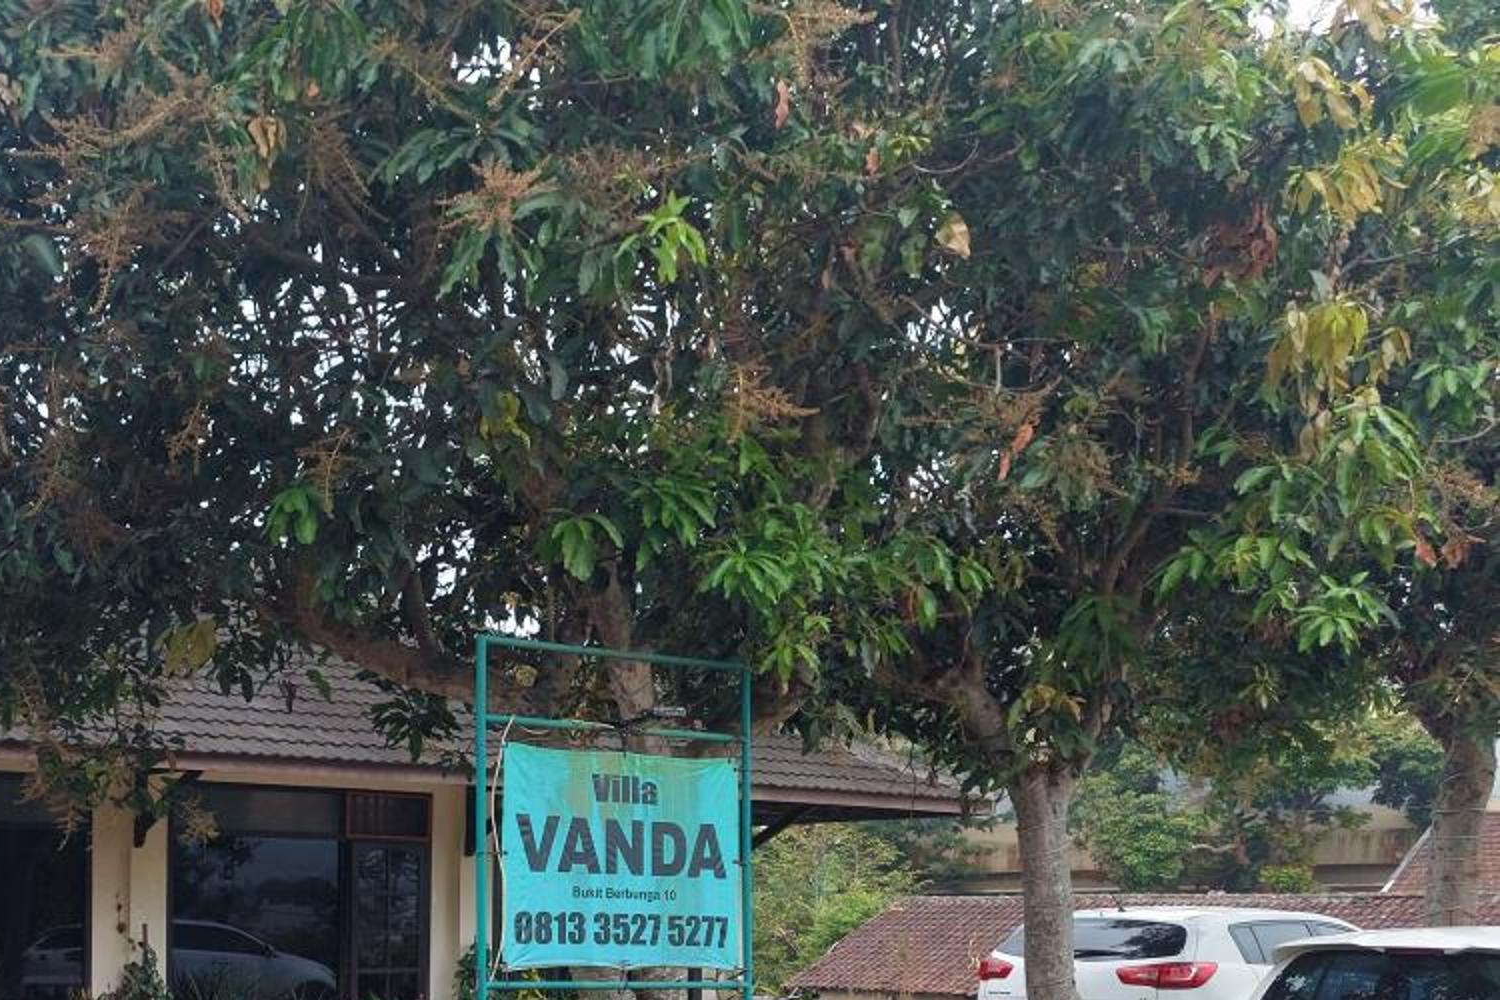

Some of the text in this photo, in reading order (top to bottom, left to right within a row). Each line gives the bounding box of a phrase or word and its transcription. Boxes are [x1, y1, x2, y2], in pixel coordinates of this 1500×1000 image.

[591, 773, 659, 805] Villa
[515, 813, 727, 879] VANDA
[572, 885, 677, 902] Bukit Berbunga 10
[514, 910, 729, 949] 0813 3527 5277
